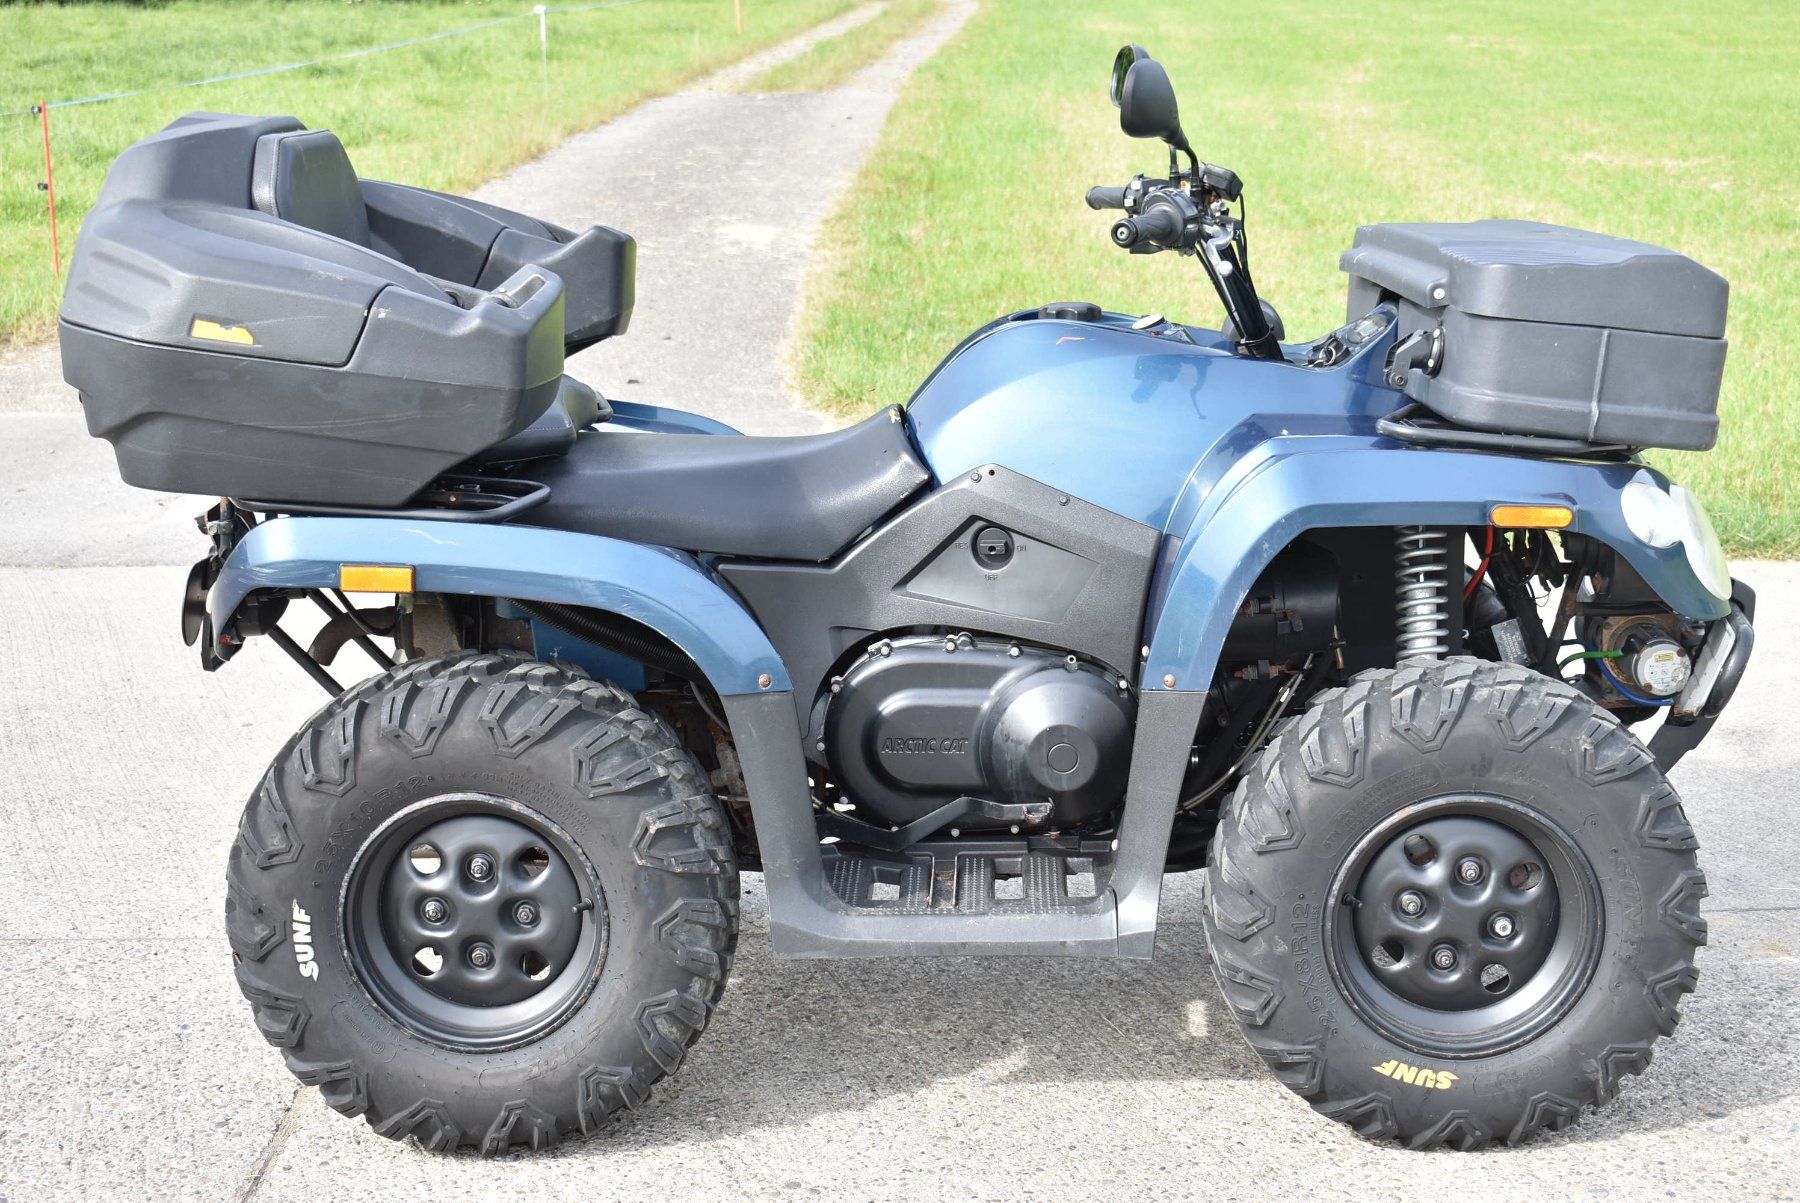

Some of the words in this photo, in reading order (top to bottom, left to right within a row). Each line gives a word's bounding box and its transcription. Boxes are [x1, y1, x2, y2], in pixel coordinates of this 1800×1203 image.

[881, 737, 936, 754] ARCTIC
[940, 737, 969, 754] CAT
[292, 898, 320, 983] SUNF
[1371, 1059, 1461, 1090] SUNF
